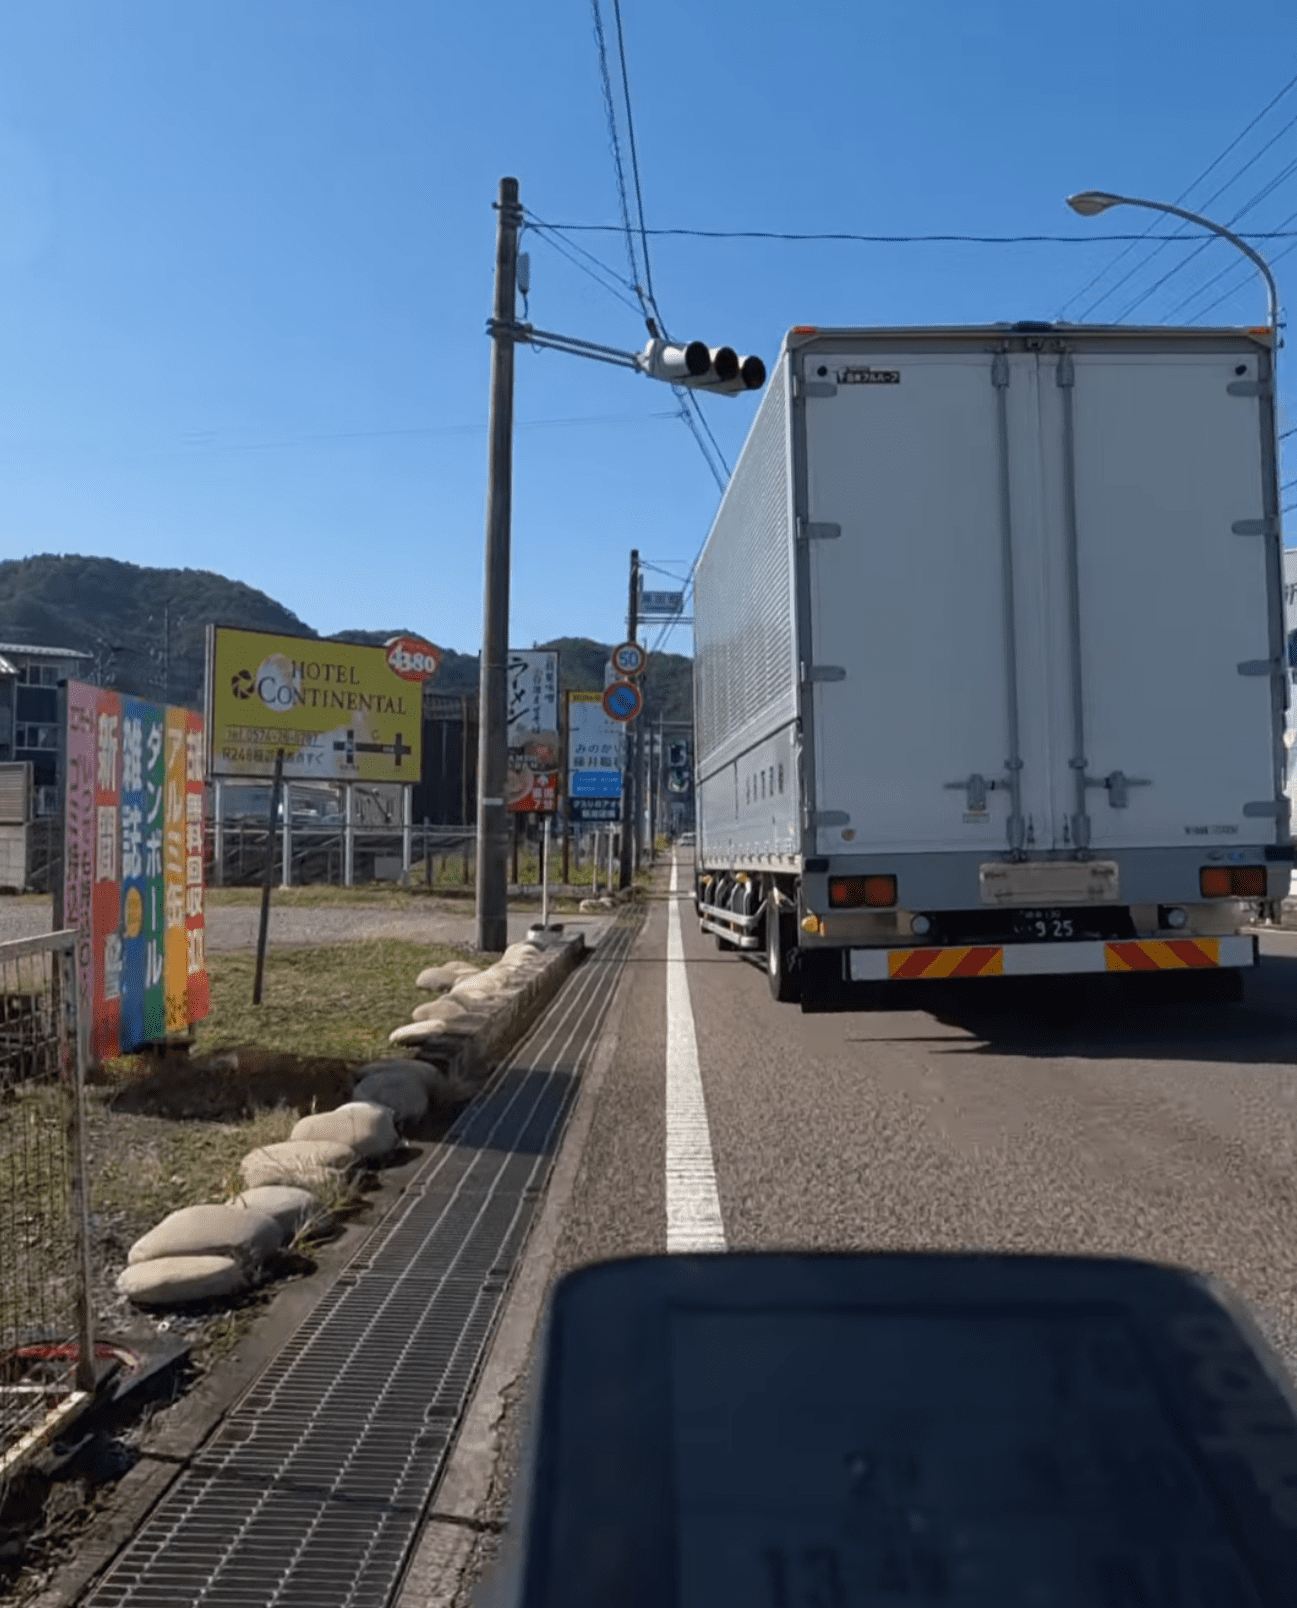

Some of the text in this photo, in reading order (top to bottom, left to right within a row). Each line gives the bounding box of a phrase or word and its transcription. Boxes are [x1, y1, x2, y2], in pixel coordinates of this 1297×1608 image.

[292, 659, 360, 686] HOTEL
[619, 650, 639, 668] 50
[96, 712, 118, 883] 新聞
[122, 716, 142, 878] 雑誌
[146, 720, 163, 989] ダンボール
[166, 728, 184, 930] アルミ缶
